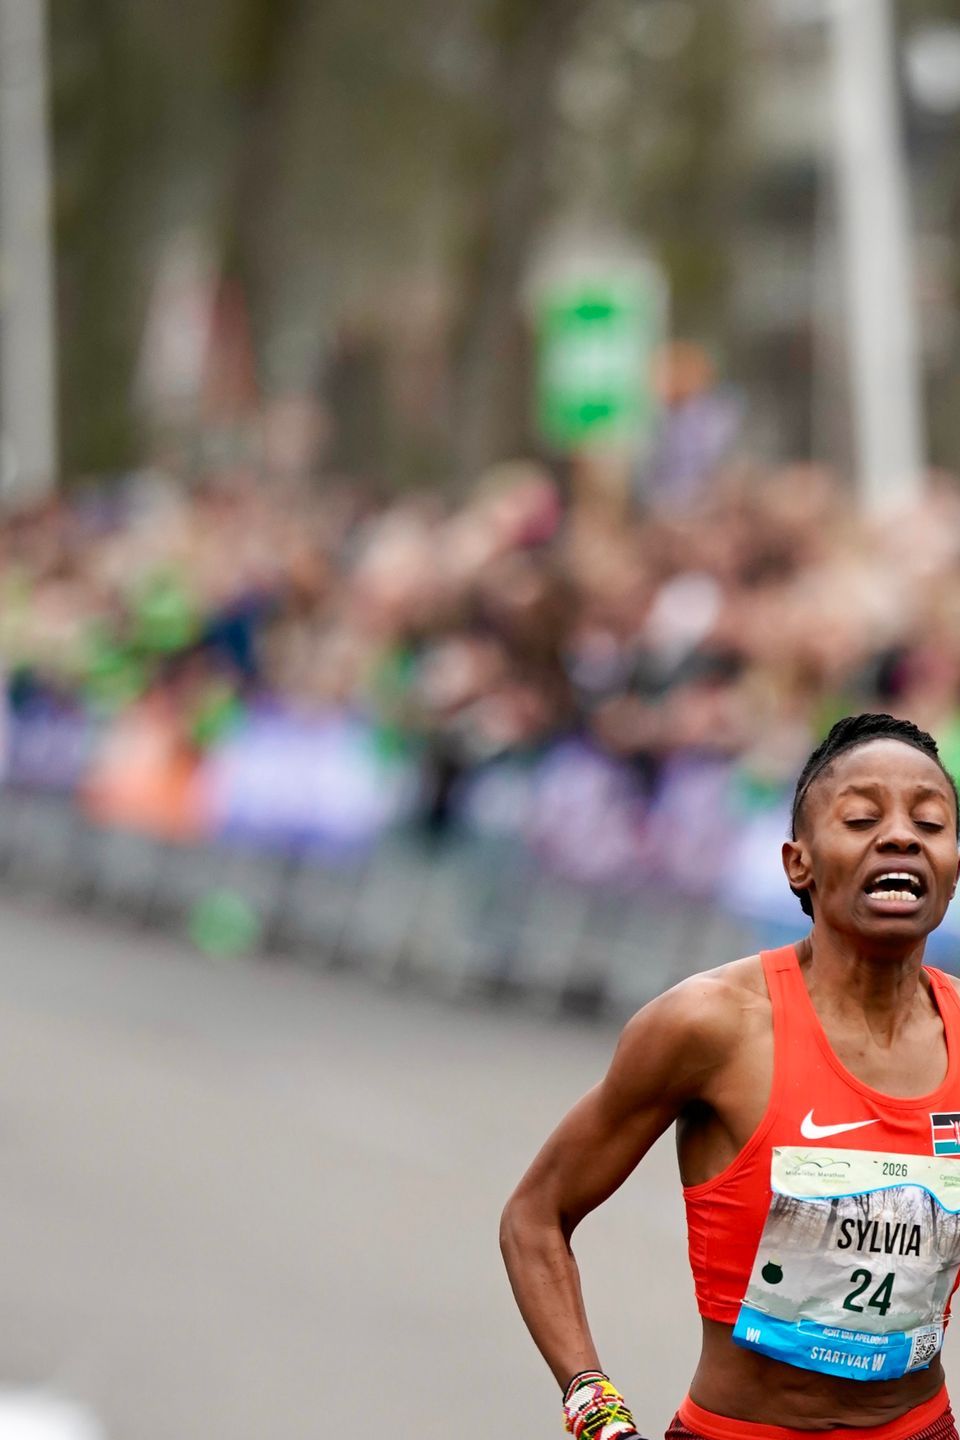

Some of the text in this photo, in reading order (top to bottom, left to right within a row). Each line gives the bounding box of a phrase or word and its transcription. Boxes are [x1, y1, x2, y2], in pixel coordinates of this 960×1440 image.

[882, 1162, 908, 1177] 2026
[837, 1218, 921, 1257] SYLVIA
[842, 1268, 896, 1316] 24
[810, 1346, 886, 1372] STARTVAK W
